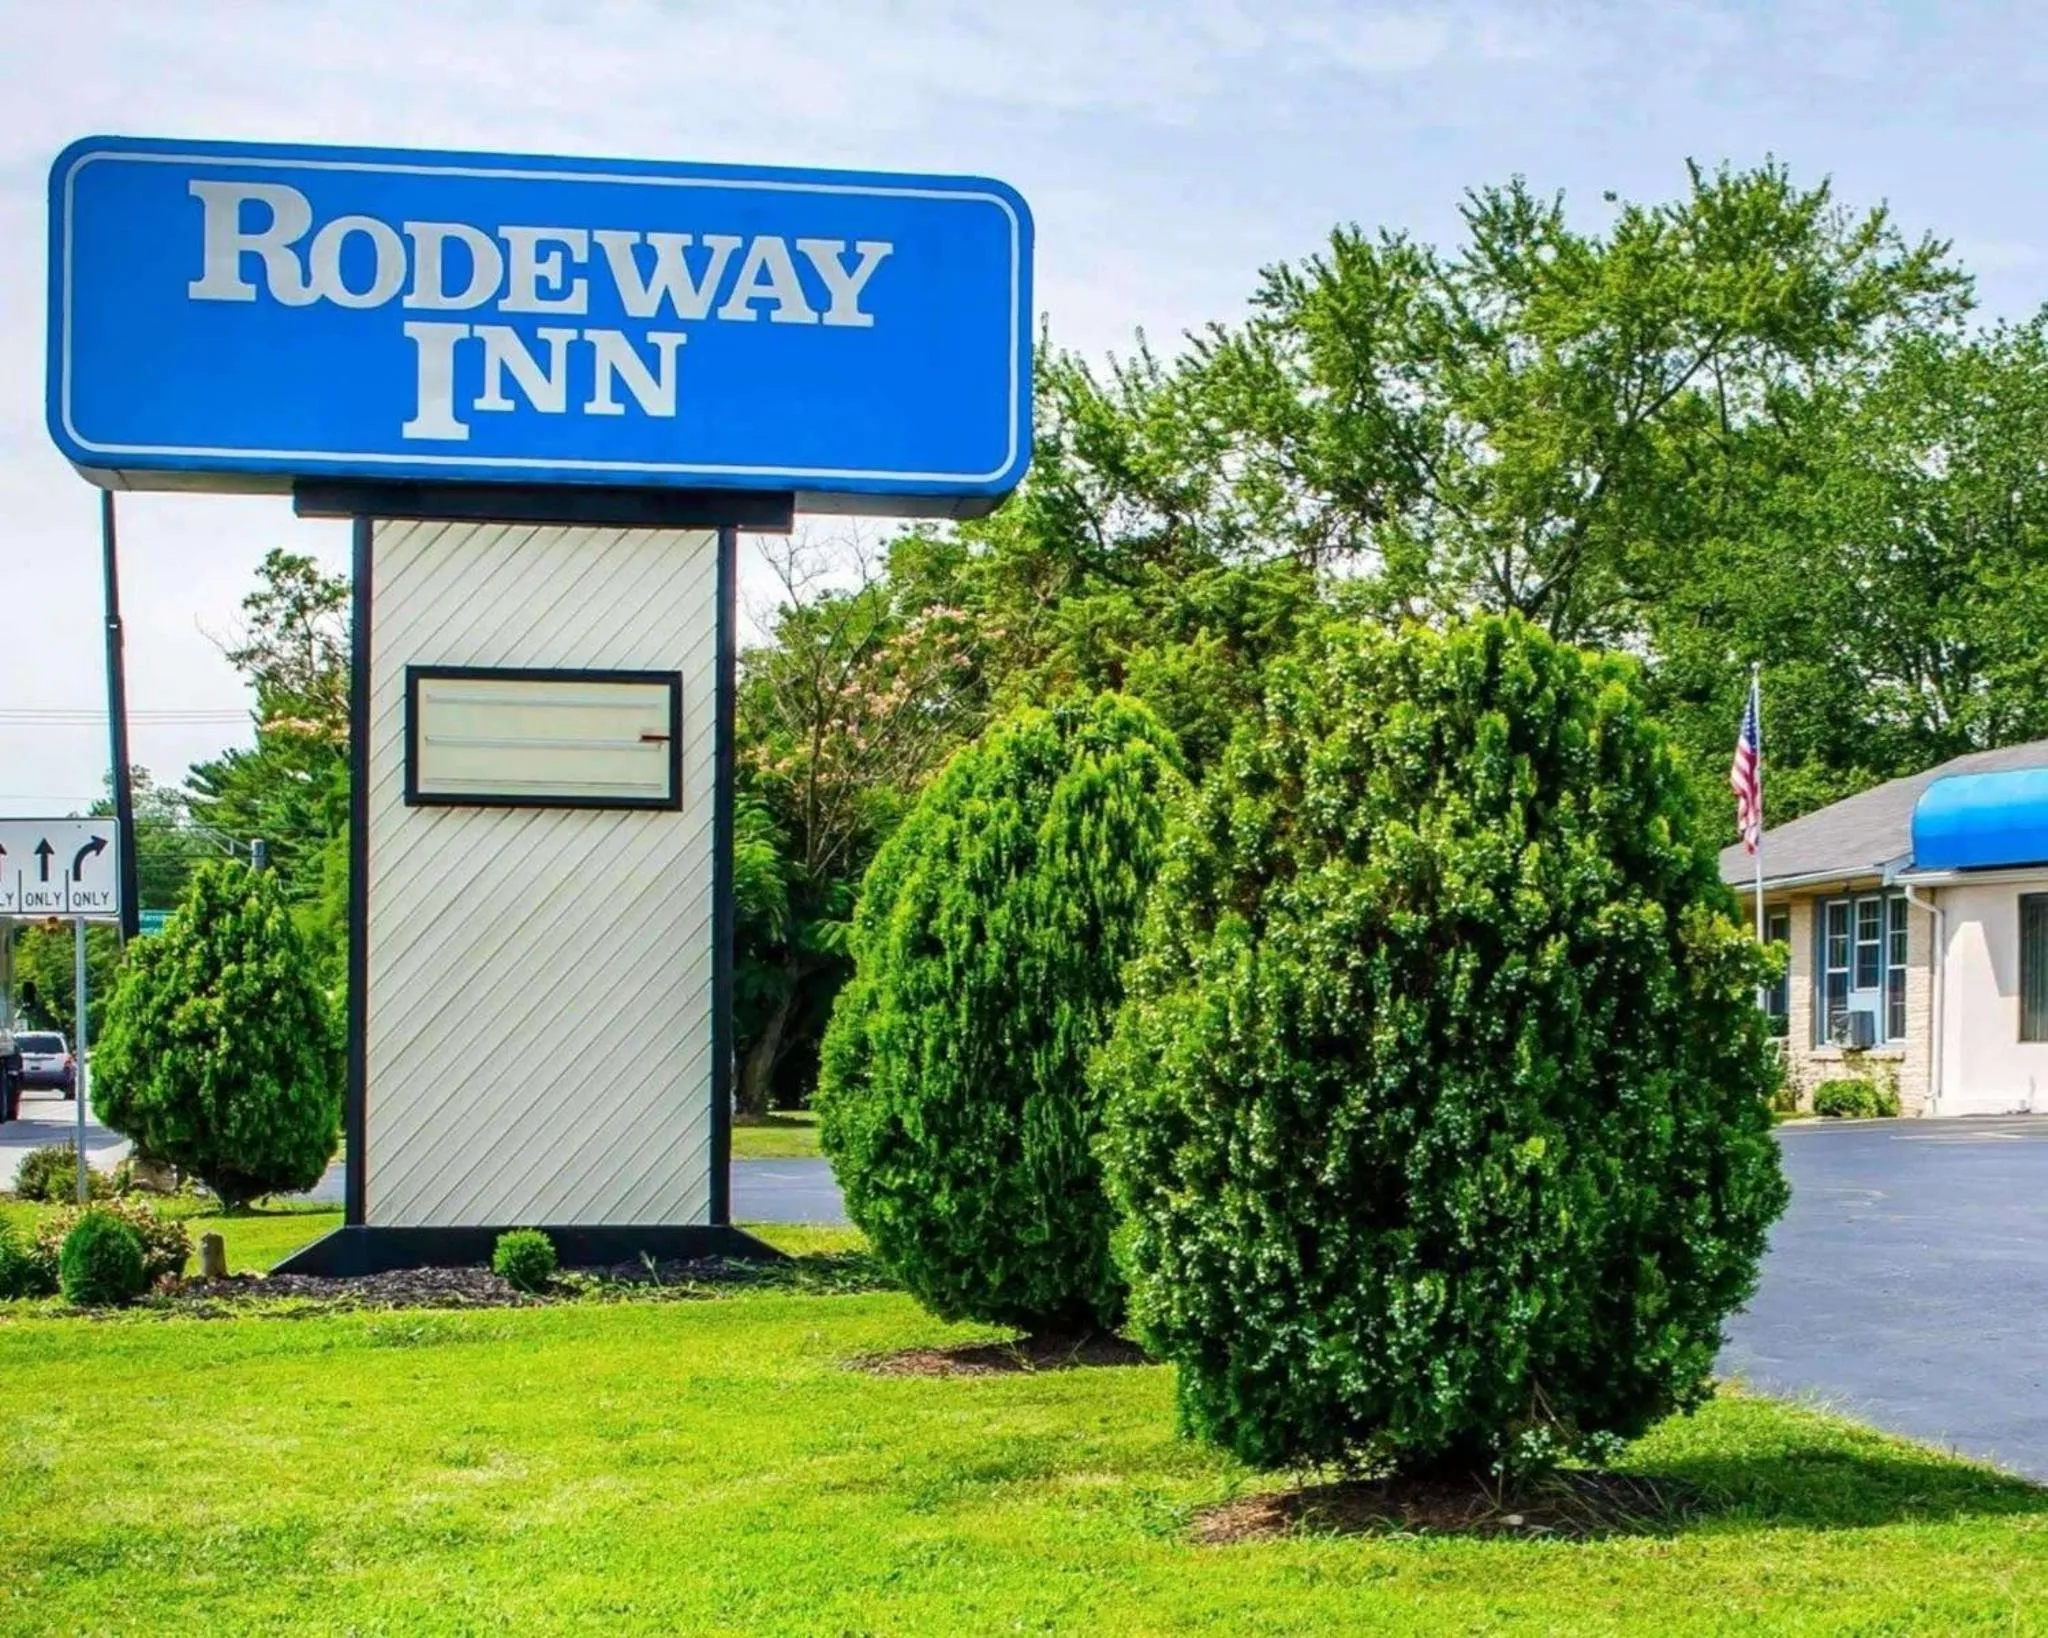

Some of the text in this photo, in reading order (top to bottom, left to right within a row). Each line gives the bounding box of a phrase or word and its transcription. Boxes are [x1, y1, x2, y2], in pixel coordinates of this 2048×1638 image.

[189, 179, 892, 327] RODEWAY
[402, 321, 687, 441] INN
[25, 892, 62, 907] ONLY
[73, 891, 110, 907] ONLY
